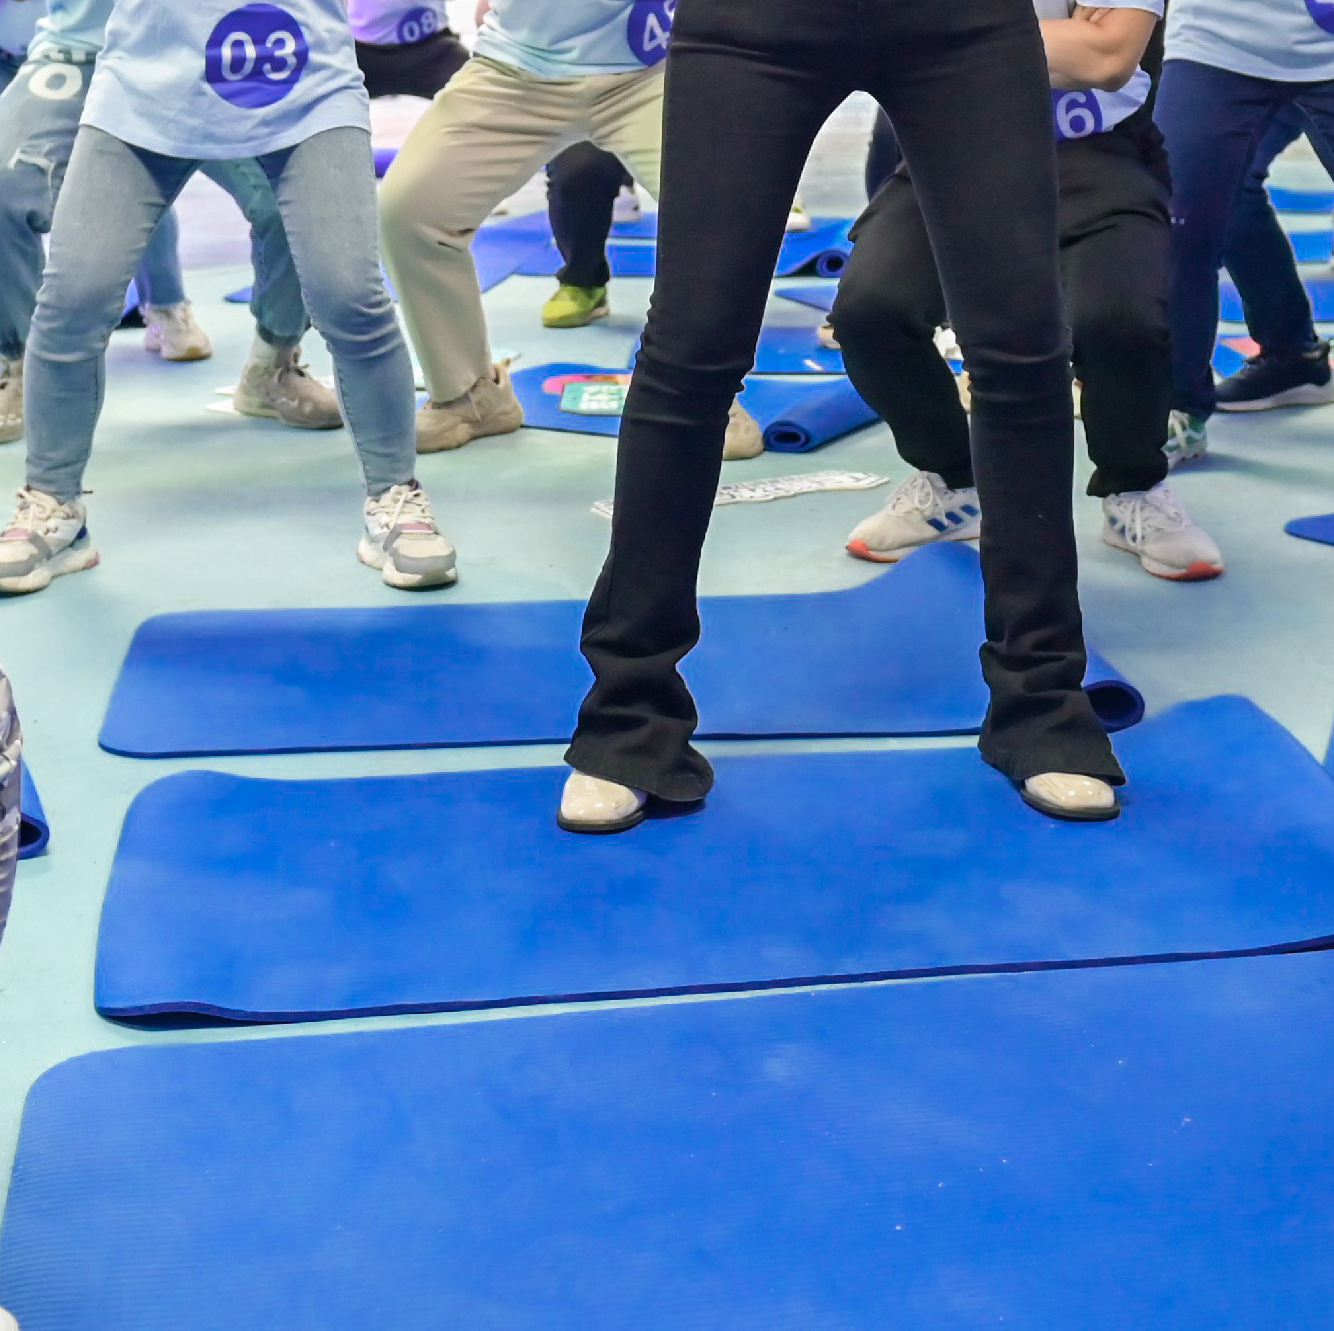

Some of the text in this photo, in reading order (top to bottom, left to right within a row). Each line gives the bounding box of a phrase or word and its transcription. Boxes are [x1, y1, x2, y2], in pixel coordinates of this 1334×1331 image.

[402, 10, 436, 43] 08
[221, 31, 298, 81] 03
[1055, 91, 1095, 139] 6
